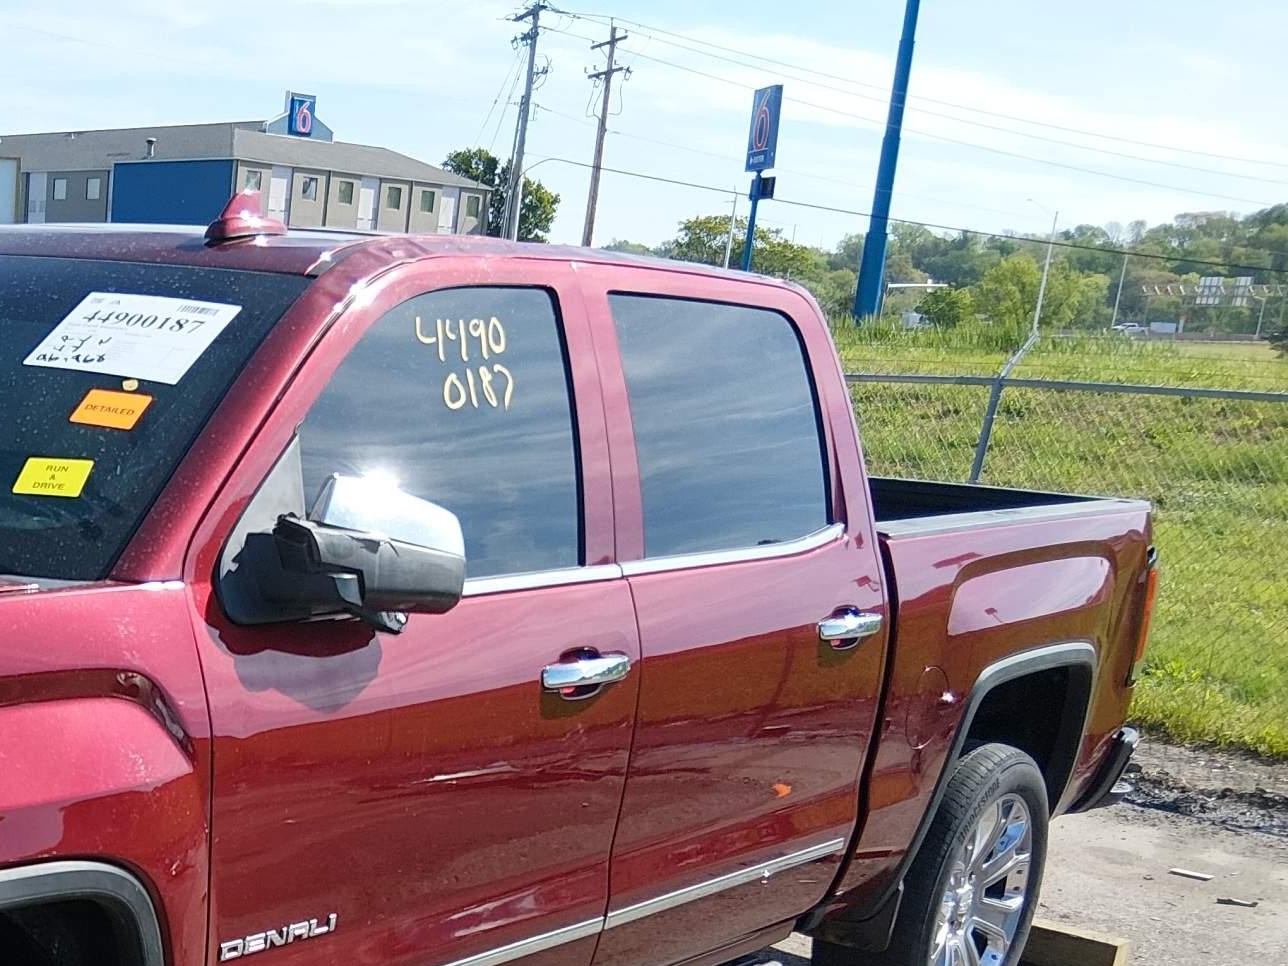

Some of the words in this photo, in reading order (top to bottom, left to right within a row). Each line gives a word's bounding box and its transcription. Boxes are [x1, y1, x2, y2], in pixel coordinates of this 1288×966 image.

[297, 101, 312, 133] 6
[753, 88, 771, 150] 6
[83, 309, 205, 334] 44900187
[415, 316, 506, 362] 4490
[443, 363, 514, 411] 0187
[84, 403, 135, 416] DETAILED
[45, 464, 69, 473] RUN
[32, 481, 65, 490] DRIVE
[219, 912, 337, 962] DENALI
